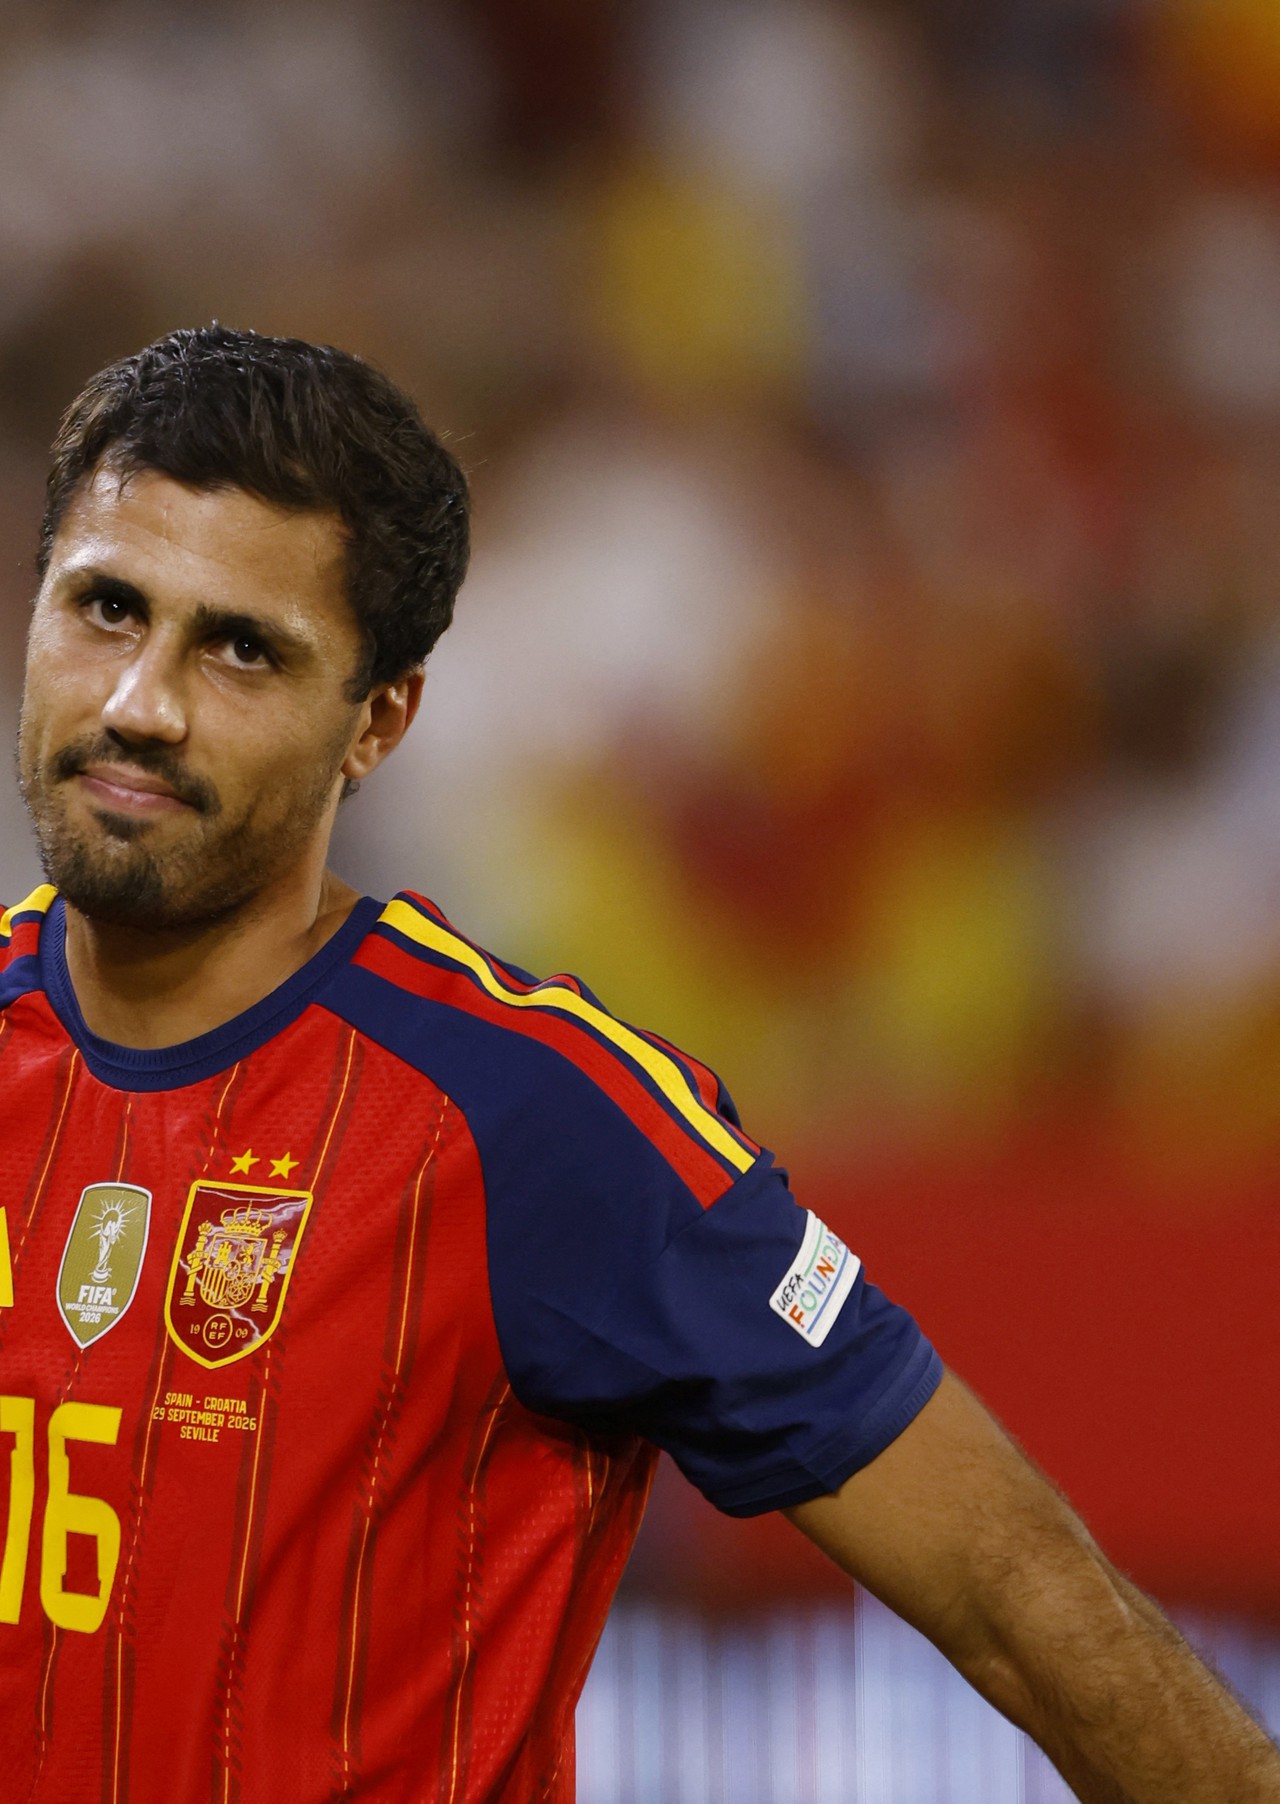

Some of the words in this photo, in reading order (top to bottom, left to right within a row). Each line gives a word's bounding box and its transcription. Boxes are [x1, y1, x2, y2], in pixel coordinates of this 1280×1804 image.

[788, 1230, 844, 1328] FOUNDA
[776, 1273, 804, 1311] UEFA
[79, 1311, 101, 1324] 2026
[190, 1324, 200, 1335] 19
[235, 1328, 248, 1338] 09
[164, 1392, 193, 1408] SPAIN
[204, 1396, 247, 1414] CROATIA
[153, 1407, 165, 1420] 29
[167, 1408, 225, 1427] SEPTEMBER
[227, 1415, 257, 1431] 2026
[180, 1425, 220, 1442] SEVILLE
